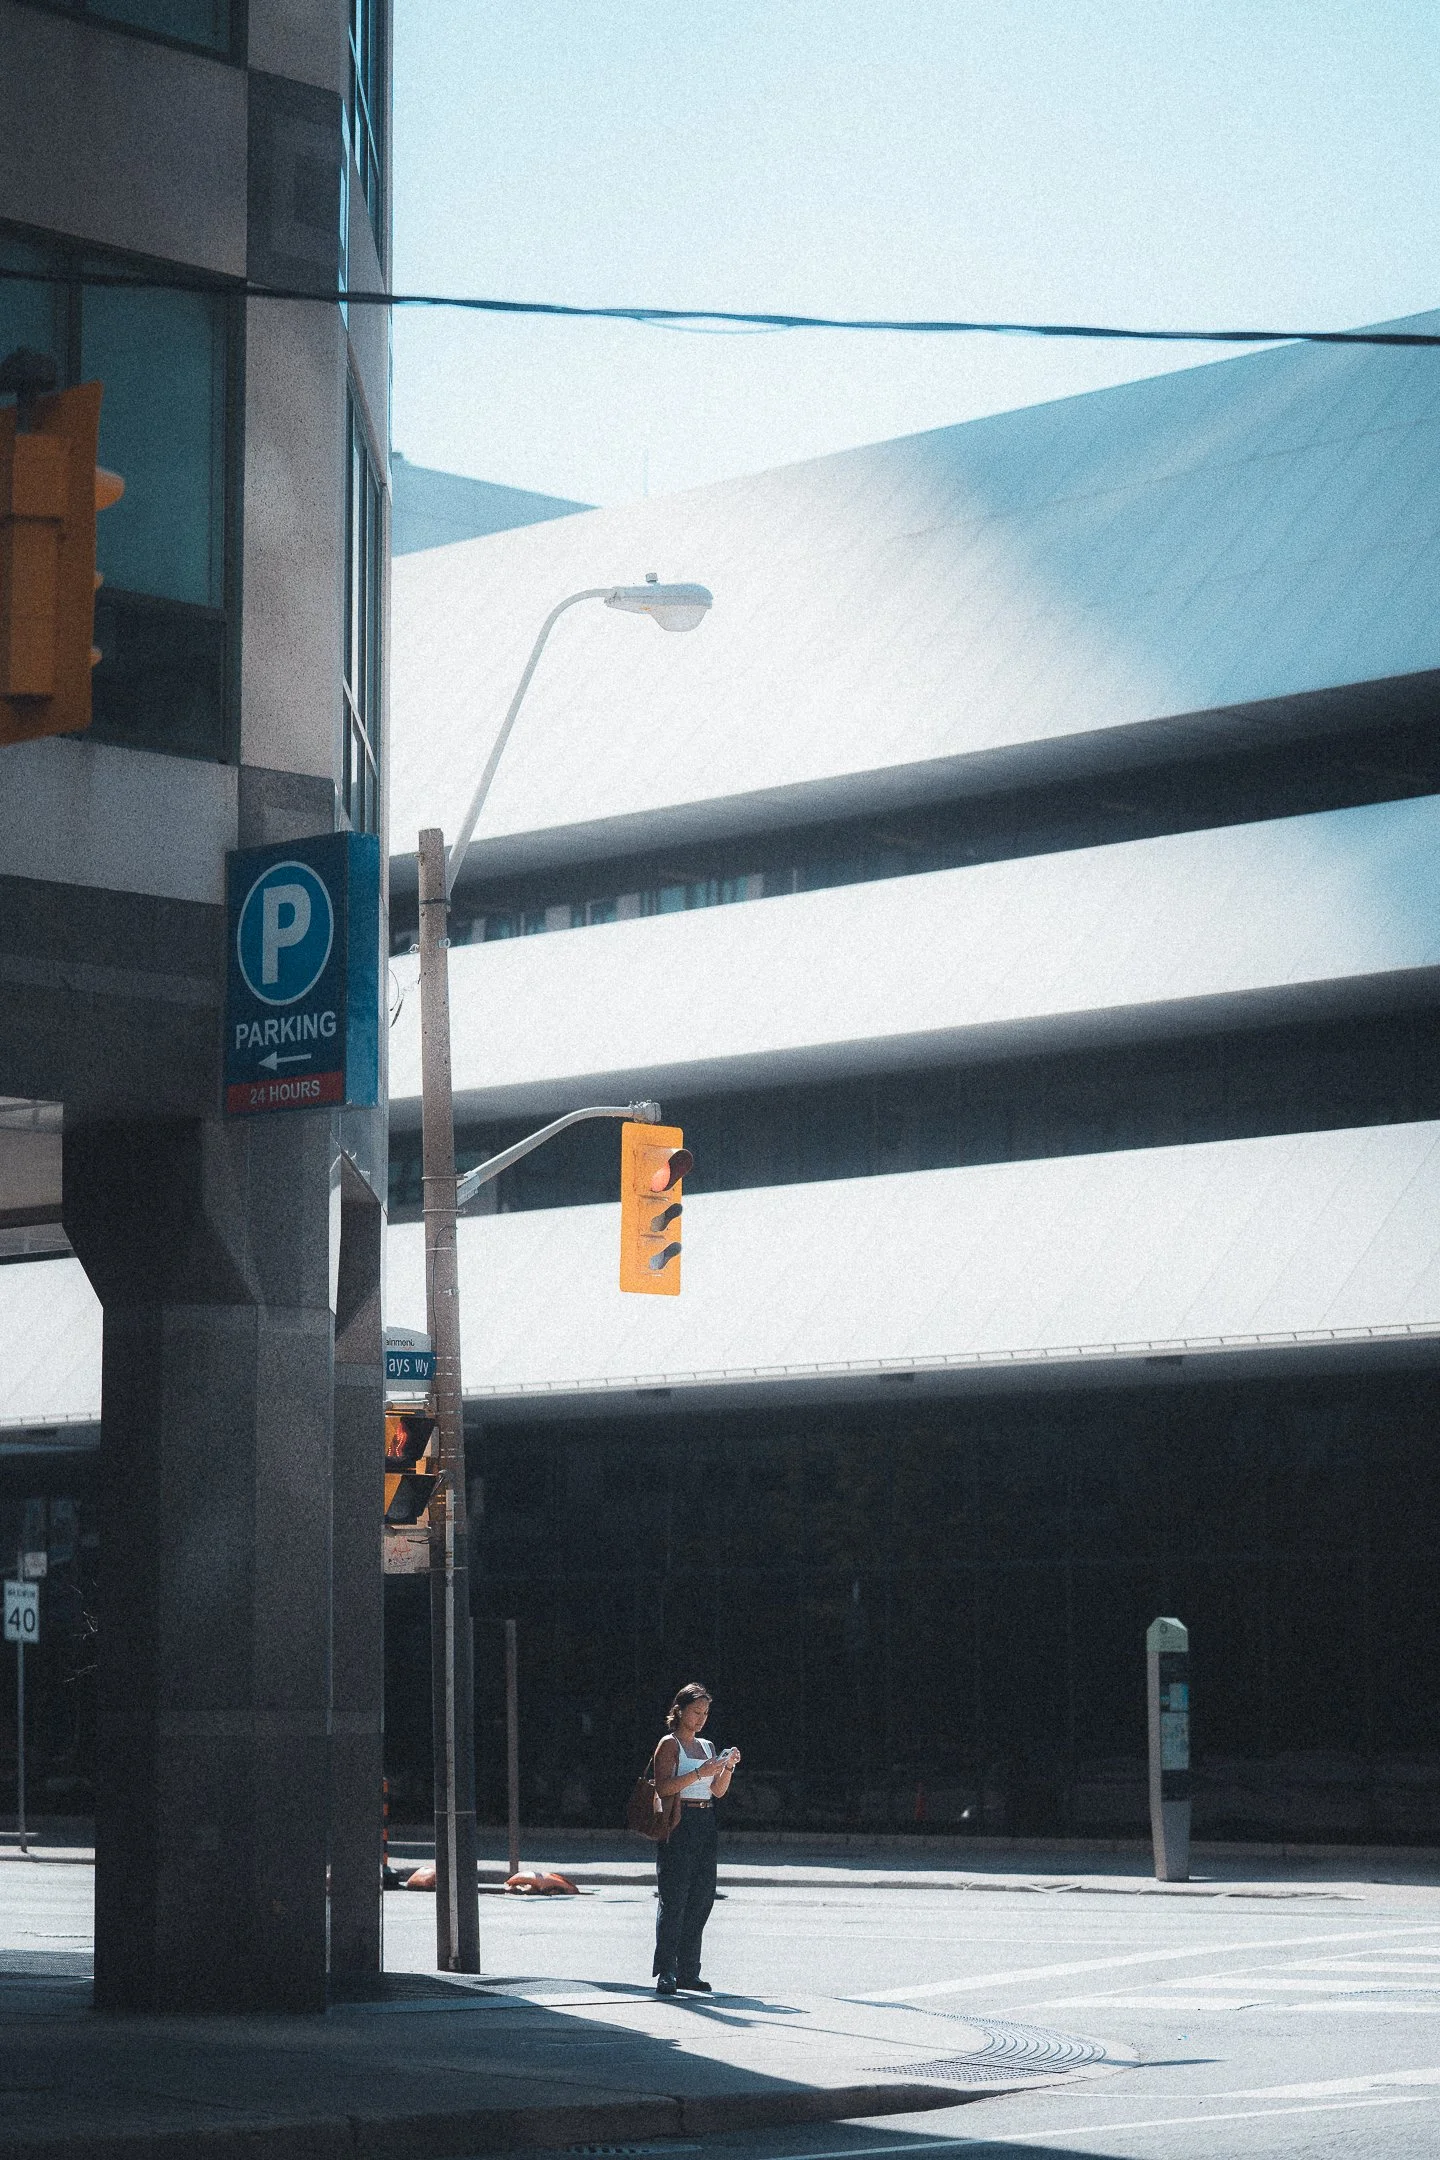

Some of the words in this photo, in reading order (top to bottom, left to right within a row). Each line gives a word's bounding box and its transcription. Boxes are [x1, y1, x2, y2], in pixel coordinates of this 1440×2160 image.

[262, 883, 312, 985] P
[235, 1010, 337, 1050] PARKING
[250, 1087, 266, 1105] 24
[269, 1080, 321, 1102] HOURS
[415, 1359, 429, 1376] Wy
[7, 1607, 36, 1633] 40
